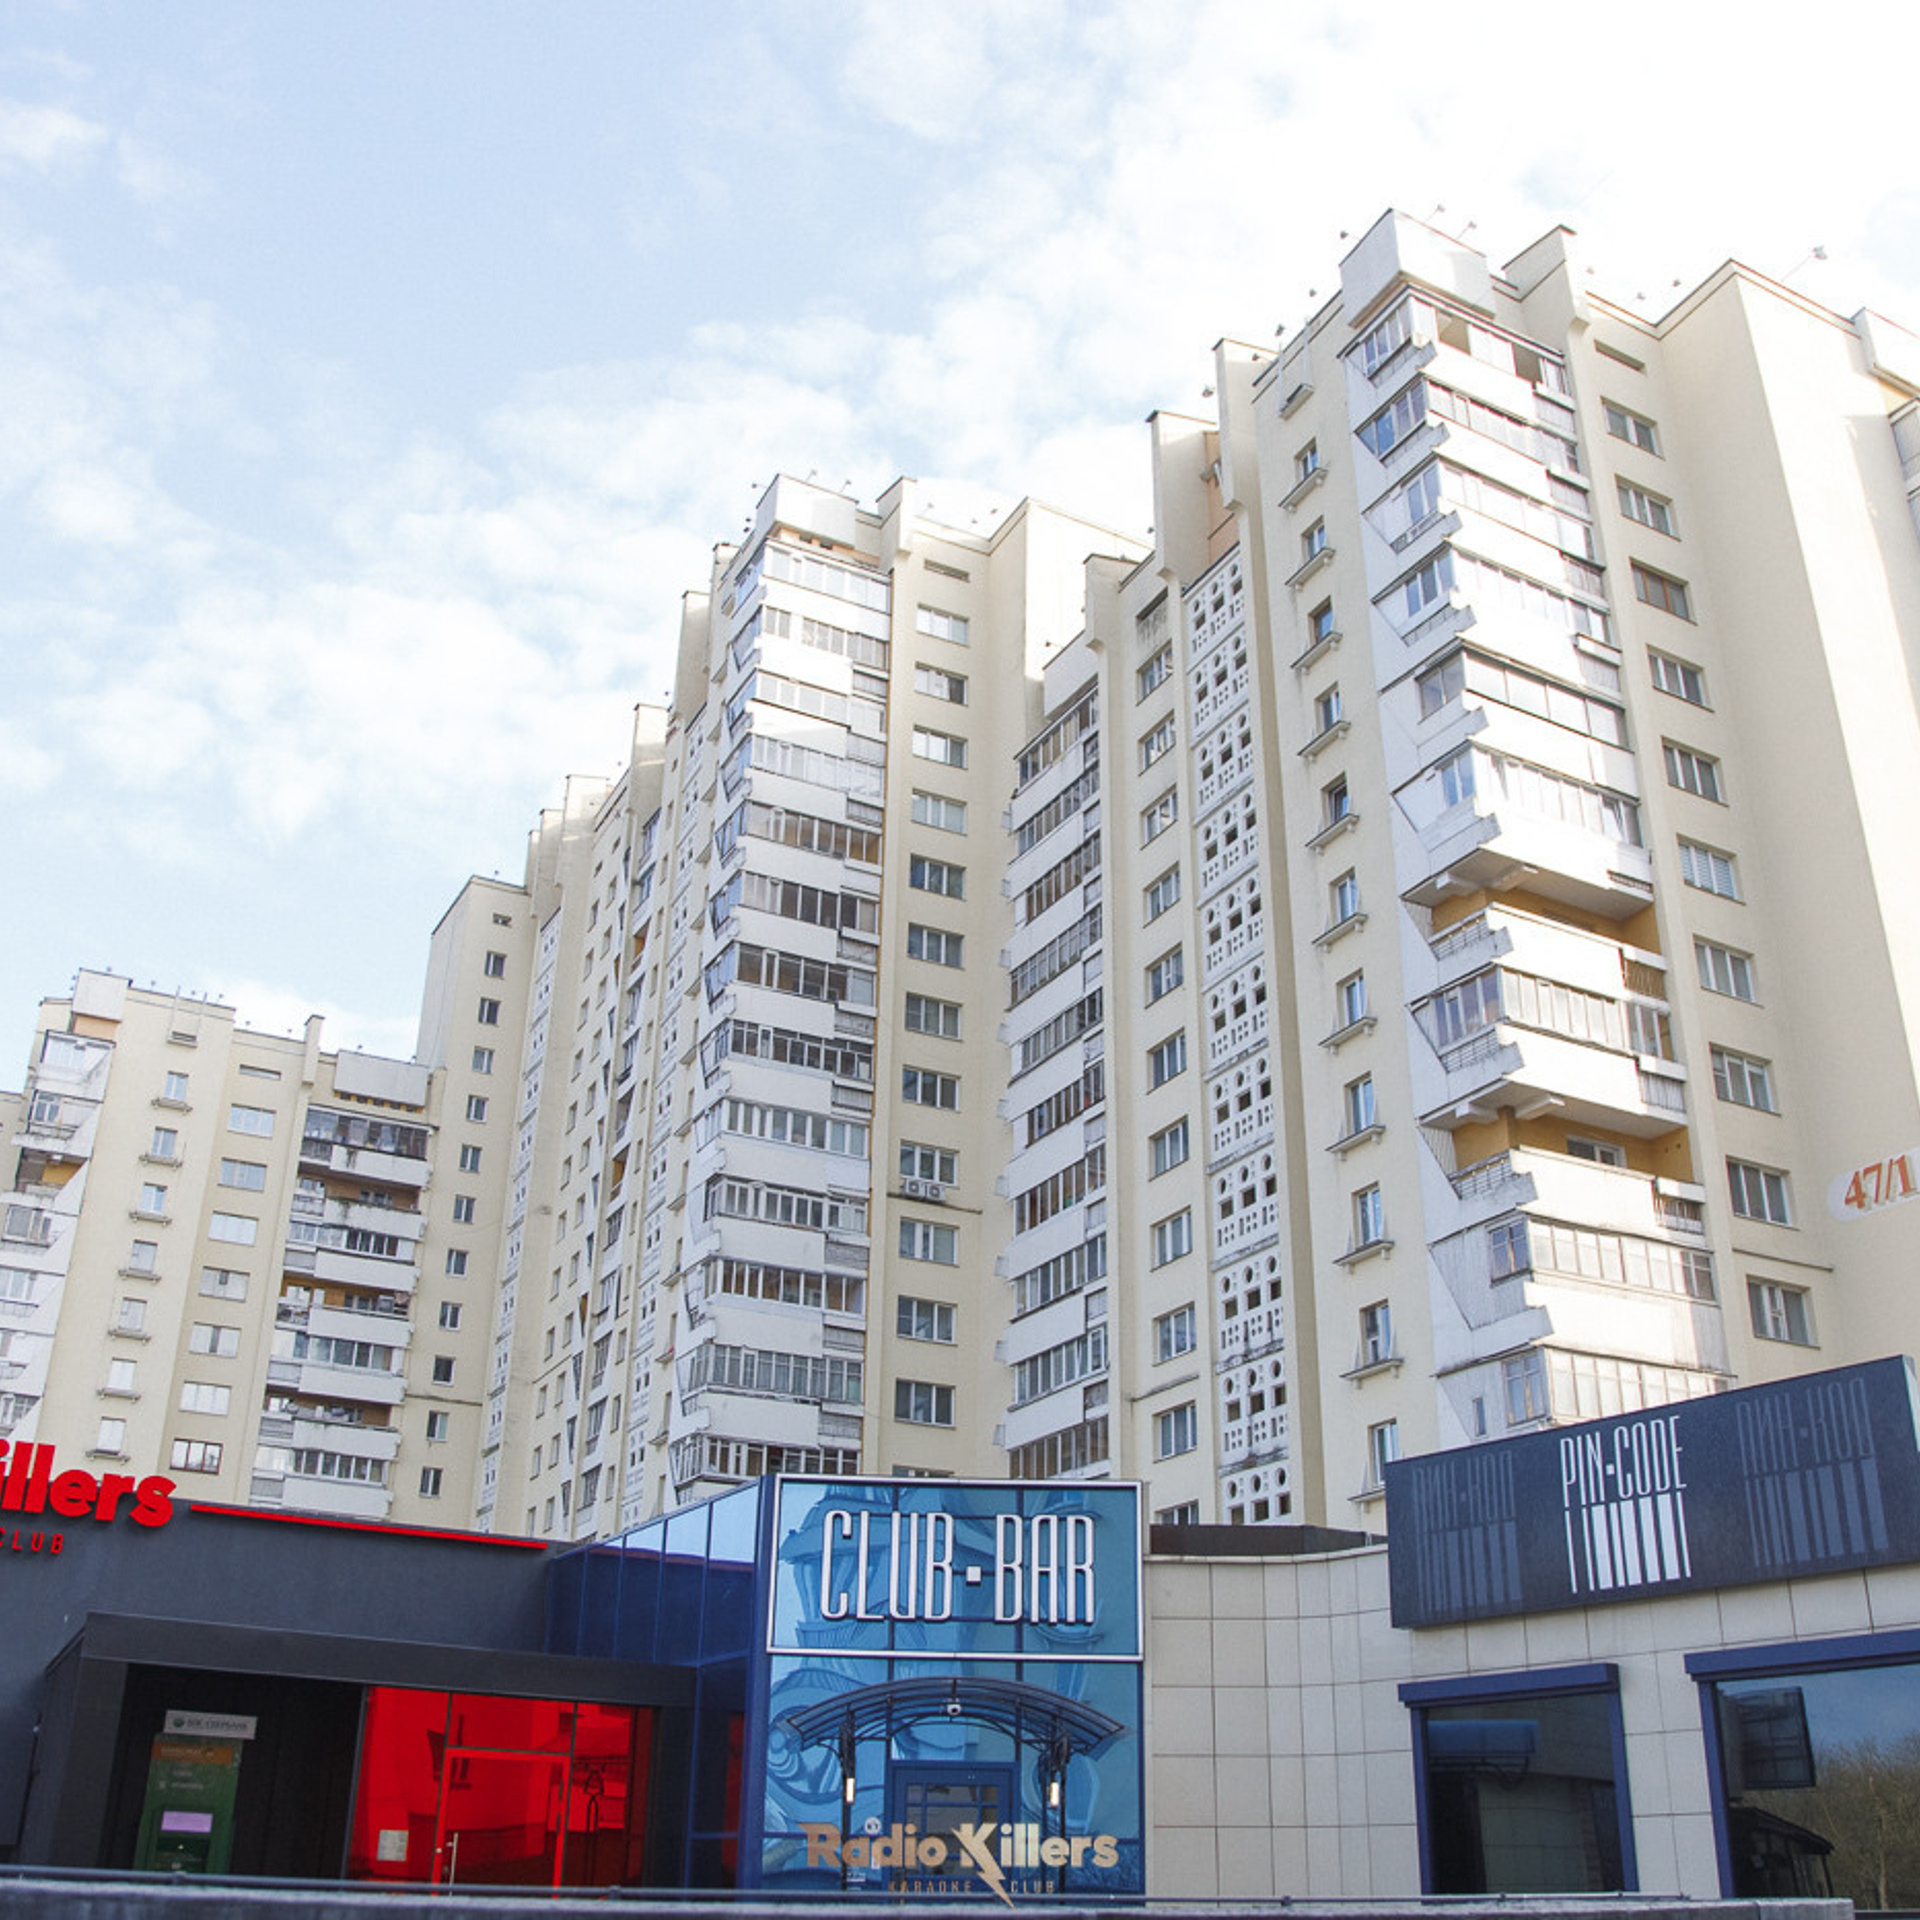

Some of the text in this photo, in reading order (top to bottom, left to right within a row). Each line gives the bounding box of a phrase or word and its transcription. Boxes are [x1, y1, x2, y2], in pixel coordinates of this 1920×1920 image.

[1844, 1154, 1911, 1209] 47/1
[799, 1823, 1118, 1880] Radio Killers
[889, 1880, 1055, 1894] KARAOKE CLUB
